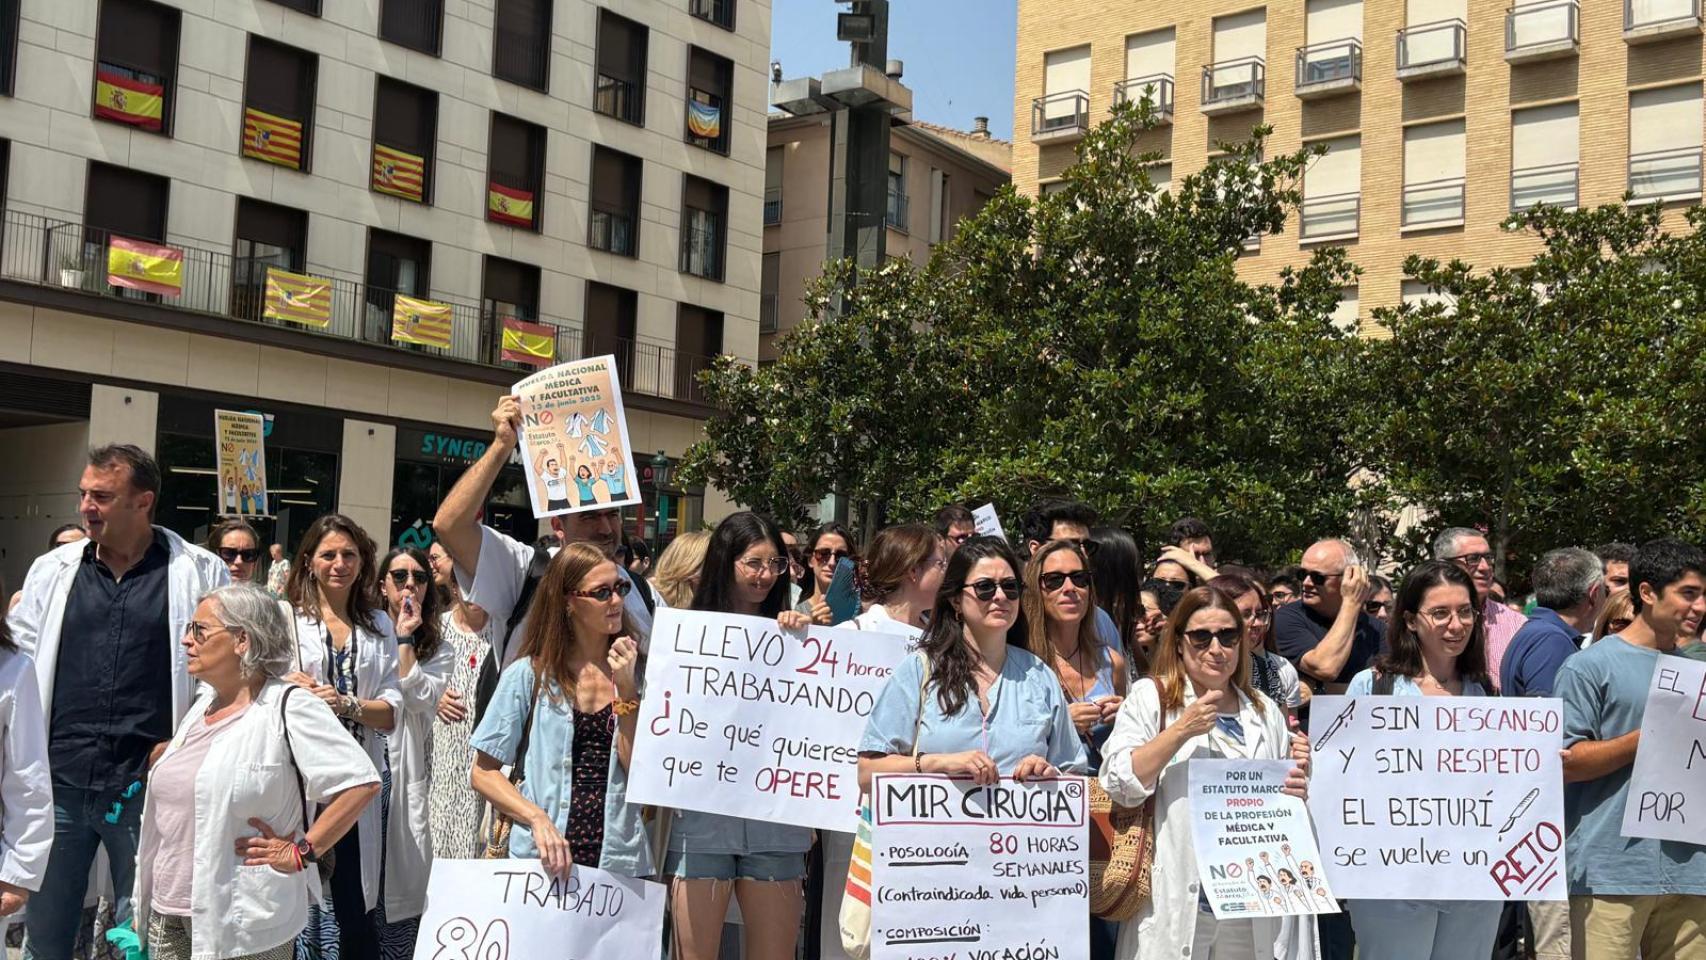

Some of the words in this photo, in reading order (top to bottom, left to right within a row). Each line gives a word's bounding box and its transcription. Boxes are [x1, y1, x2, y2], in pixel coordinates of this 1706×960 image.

[557, 363, 607, 378] NACIONAL
[530, 395, 536, 403] Y
[540, 385, 600, 401] FACULTATIVA
[545, 401, 554, 409] de
[558, 398, 576, 408] junio
[674, 623, 784, 666] LLEVO
[796, 637, 839, 678] 24
[679, 665, 874, 717] TRABAJANDO
[1657, 668, 1686, 695] EL
[1371, 705, 1420, 730] SIN
[1436, 706, 1559, 733] DESCANSO
[723, 724, 762, 751] qué
[772, 737, 858, 767] quieres
[1339, 747, 1355, 774] Y
[1375, 748, 1423, 774] SIN
[1437, 748, 1541, 774] RESPETO
[662, 757, 703, 788] que
[717, 760, 738, 783] te
[755, 767, 841, 800] OPERE
[1202, 785, 1249, 794] ESTATUTO
[1226, 771, 1246, 781] POR
[1248, 771, 1263, 781] UN
[887, 784, 952, 818] MIR
[1204, 812, 1218, 820] DE
[1220, 811, 1233, 820] LA
[1235, 808, 1292, 820] PROFESIÓN
[1226, 798, 1264, 808] PROPIO
[1343, 798, 1375, 825] EL
[1388, 790, 1494, 828] BISTURÍ
[1639, 791, 1686, 824] POR
[1218, 833, 1289, 846] FACULTATIVA
[1225, 822, 1266, 833] MÉDICA
[1267, 822, 1275, 831] Y
[989, 832, 1018, 854] 80
[1027, 835, 1079, 854] HORAS
[1335, 846, 1367, 867] se
[1379, 837, 1451, 867] vuelve
[1463, 849, 1488, 867] un
[993, 860, 1085, 878] SEMANALES
[1490, 821, 1563, 897] RETO
[494, 871, 624, 917] TRABAJO
[877, 885, 994, 904] (Contraindicada
[1031, 880, 1089, 908] personal)
[968, 938, 1059, 960] VOCACIÓN
